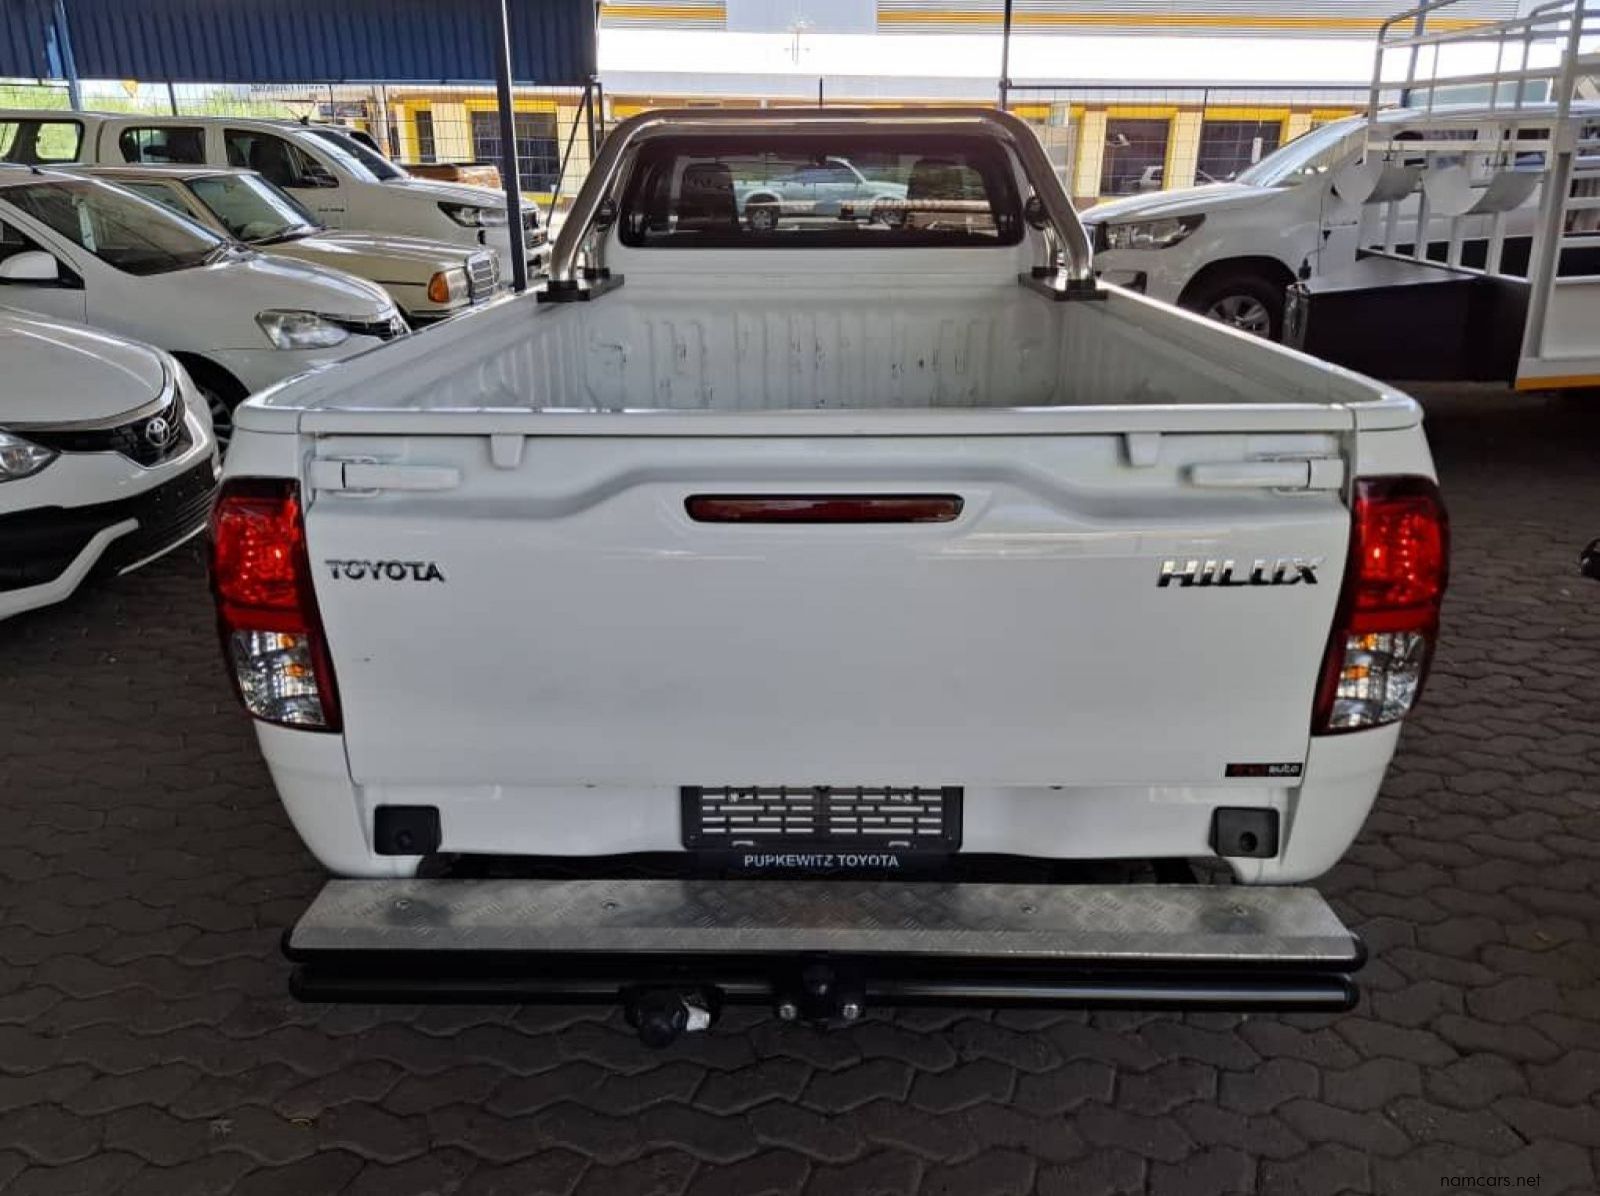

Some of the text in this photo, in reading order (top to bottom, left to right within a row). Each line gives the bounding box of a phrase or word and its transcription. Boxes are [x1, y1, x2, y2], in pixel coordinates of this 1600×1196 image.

[324, 559, 445, 582] TOYOTA
[1156, 557, 1323, 587] HILUX
[744, 853, 900, 868] PUPKEWITZ TOYOTA
